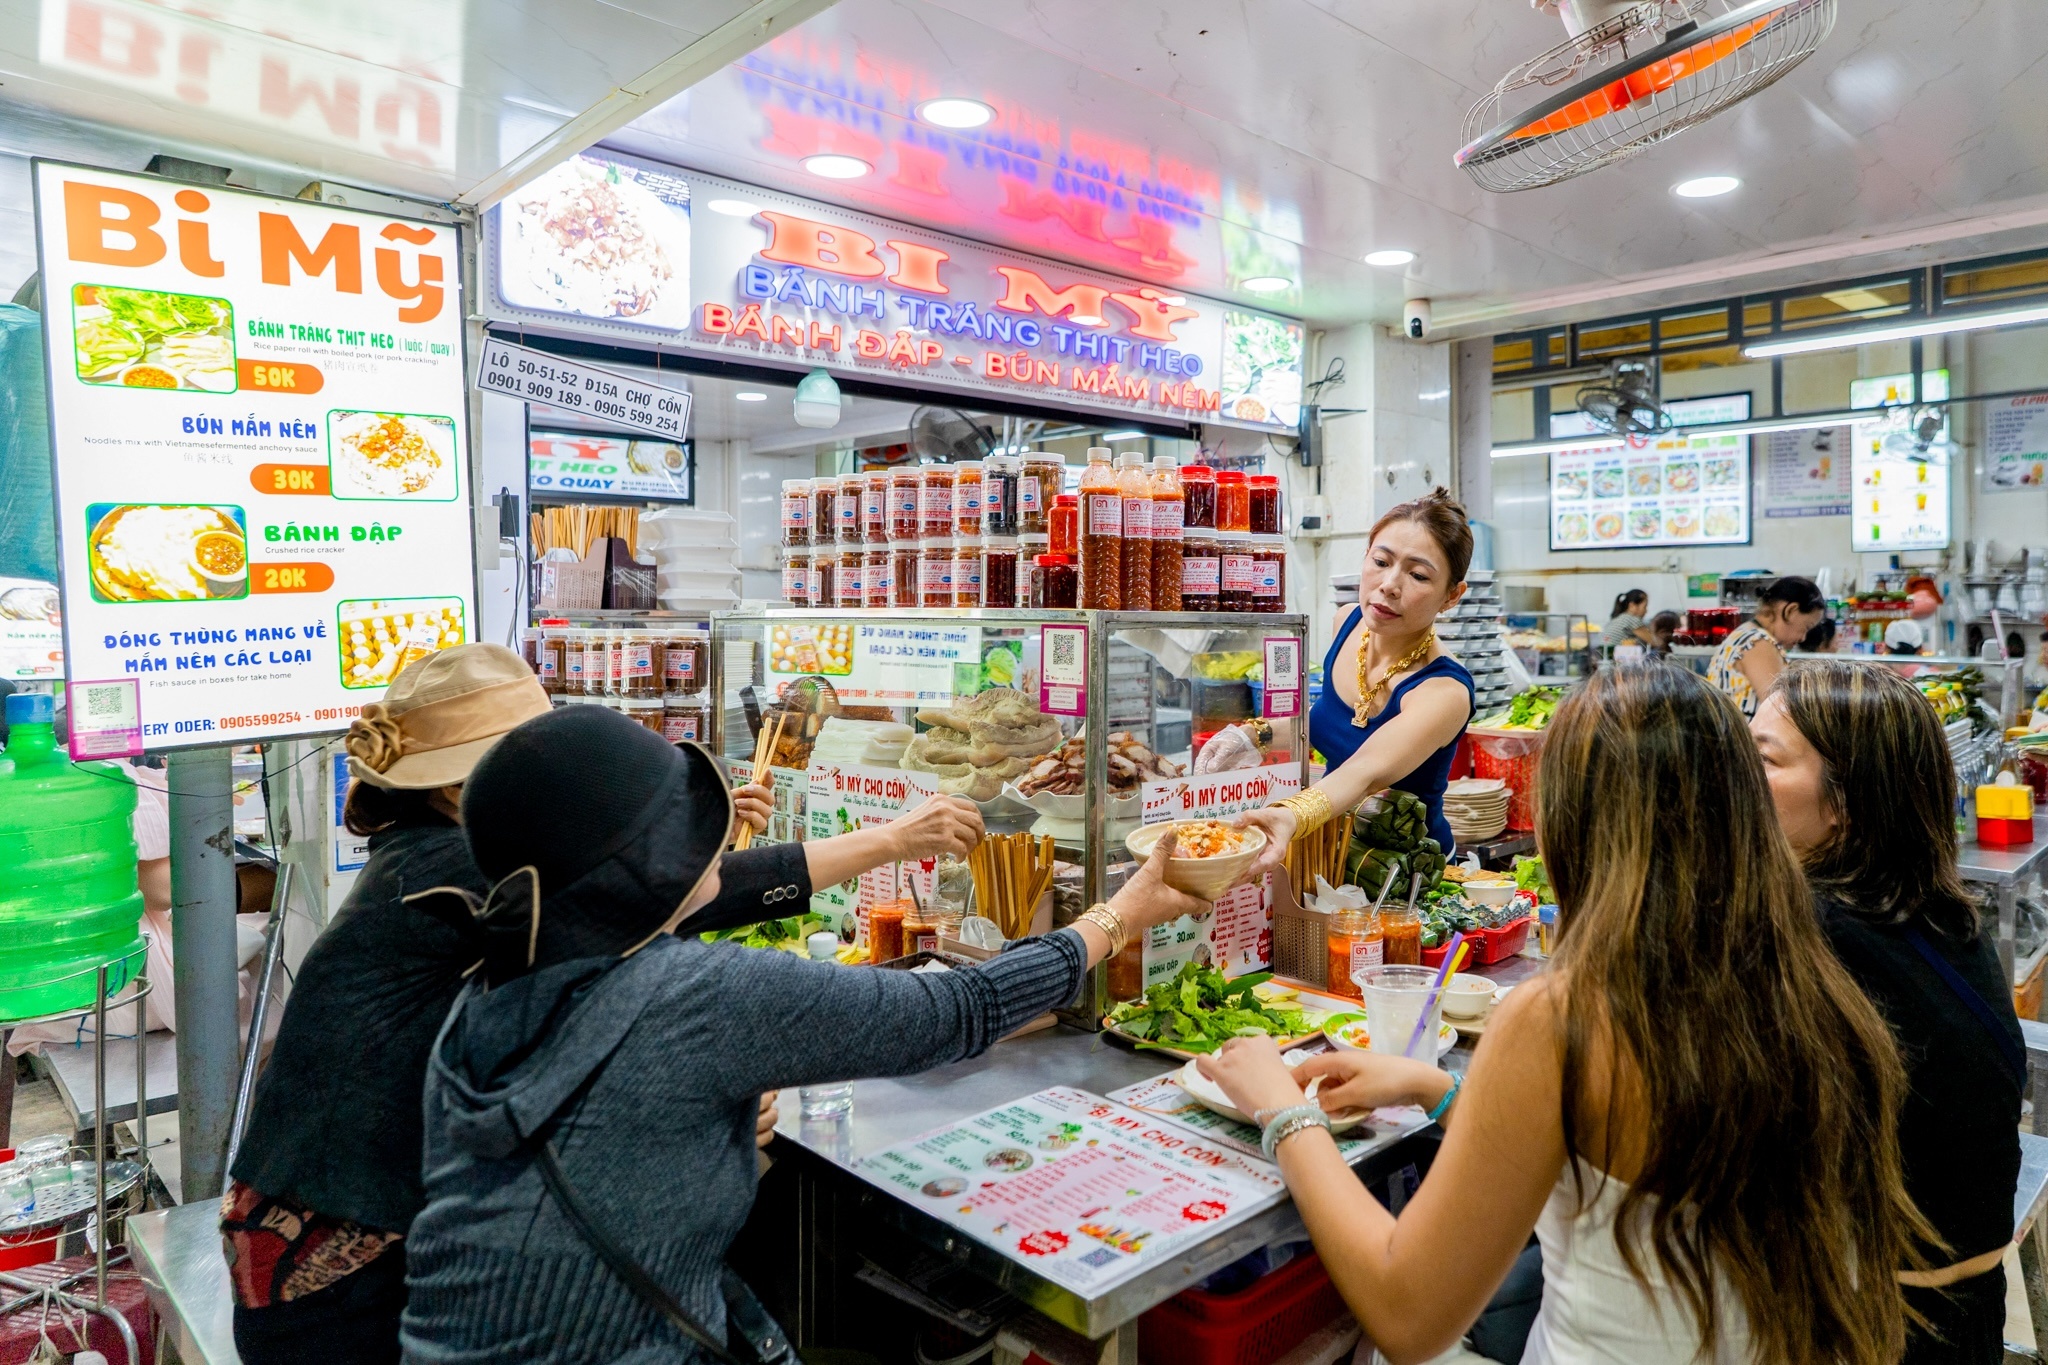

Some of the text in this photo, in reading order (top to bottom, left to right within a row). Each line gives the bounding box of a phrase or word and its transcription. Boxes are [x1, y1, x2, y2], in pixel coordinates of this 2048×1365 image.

[63, 180, 445, 324] Bi Mỹ
[758, 210, 1199, 342] BI MỸ
[743, 262, 1203, 377] BÁNH TRÁNG THỊT HEO
[248, 317, 285, 339] BÁNH
[289, 322, 332, 343] TRÁNG
[337, 329, 366, 350] THỊT
[370, 333, 394, 349] HEO
[431, 342, 450, 356] quay
[254, 341, 271, 350] Rice
[273, 344, 296, 353] paper
[298, 345, 311, 353] roll
[313, 347, 329, 355] with
[331, 349, 354, 357] boiled
[356, 351, 372, 360] pork
[386, 354, 402, 362] pork
[404, 356, 439, 365] crackling)
[703, 302, 841, 353] BÁNH
[855, 330, 943, 367] ĐẬP
[985, 351, 1059, 386] BÚN
[1072, 364, 1149, 401] MẮM
[1159, 378, 1221, 412] NÊM
[253, 365, 296, 388] 50K
[491, 352, 682, 416] LÔ 50-51-52 Đ15A CHỢ CỒN
[487, 371, 522, 391] 0901
[527, 381, 553, 399] 909
[557, 390, 582, 407] 189
[594, 399, 626, 418] 0905
[629, 409, 653, 426] 599
[655, 415, 679, 432] 254
[182, 413, 317, 439] BÚN MẮM NÊM
[84, 437, 122, 445] Noodles
[144, 439, 162, 447] with
[166, 440, 257, 451] Vietnamesefermented
[259, 443, 292, 453] anchovy
[273, 469, 315, 490] 30K
[559, 462, 618, 475] HEO
[559, 477, 615, 489] QUAY
[264, 521, 402, 545] BÁNH ĐẬP
[265, 546, 299, 554] Crushed
[265, 567, 307, 588] 20K
[103, 619, 327, 649] ĐÓNG THÙNG MANG VỀ
[125, 649, 311, 673] MẮM NÊM CÁC LOẠI
[150, 680, 169, 688] Fish
[171, 679, 197, 687] sauce
[209, 675, 235, 684] boxes
[237, 674, 248, 682] for
[250, 673, 268, 681] take
[270, 671, 292, 680] home
[175, 719, 216, 734] ODER:
[220, 712, 301, 730] 0905599254
[836, 775, 845, 791] BI
[847, 774, 862, 793] MỸ
[864, 778, 883, 800] CHỢ
[886, 776, 906, 799] CỒN
[1183, 777, 1268, 810] BI MỸ CHỢ CỒN
[1176, 931, 1196, 944] 30.000
[1148, 959, 1179, 976] BÁNH ĐẬP
[1109, 1115, 1147, 1131] MỸ
